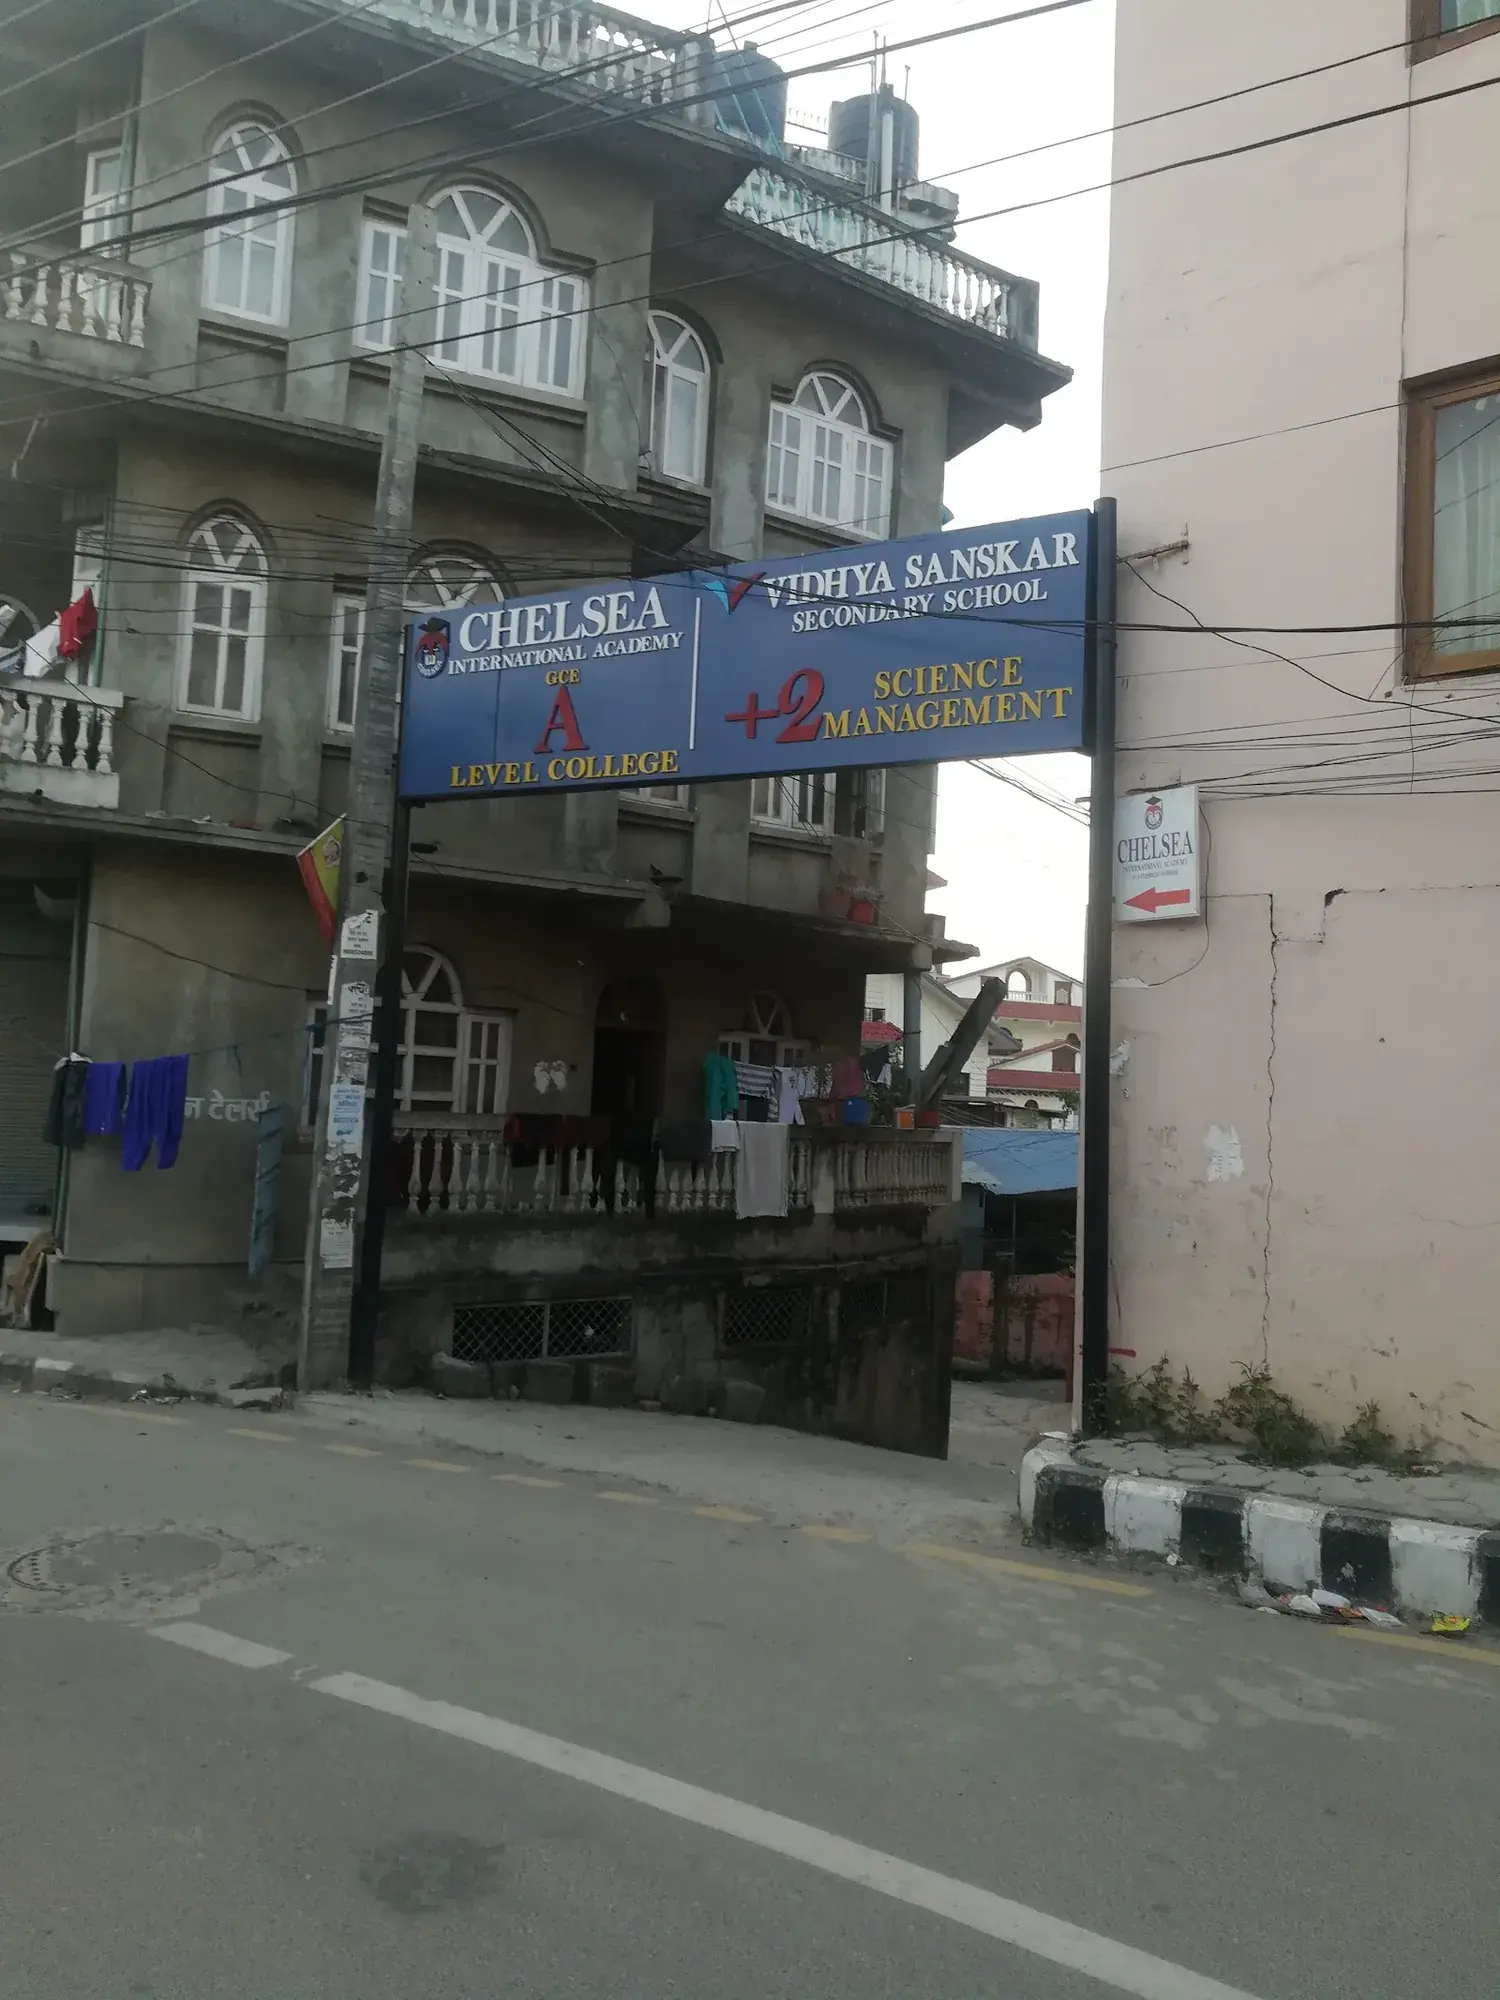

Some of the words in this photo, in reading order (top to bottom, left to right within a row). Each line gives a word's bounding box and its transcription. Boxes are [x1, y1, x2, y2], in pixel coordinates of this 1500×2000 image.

[763, 560, 896, 608] VIDHYA
[904, 532, 1080, 589] SANSKAR
[459, 586, 670, 653] CHELSEA
[791, 592, 933, 634] SECONDARY
[943, 578, 1048, 613] SCHOOL
[448, 644, 588, 676] INTERNATIONAL
[592, 631, 684, 659] ACADEMY
[545, 668, 581, 686] GCE
[873, 656, 1024, 700] SCIENCE
[533, 684, 590, 755] A
[724, 667, 825, 744] +2
[822, 687, 1073, 740] MANAGEMENT
[450, 761, 539, 788] LEVEL
[547, 750, 680, 781] COLLEGE
[1117, 830, 1194, 864] CHELSEA
